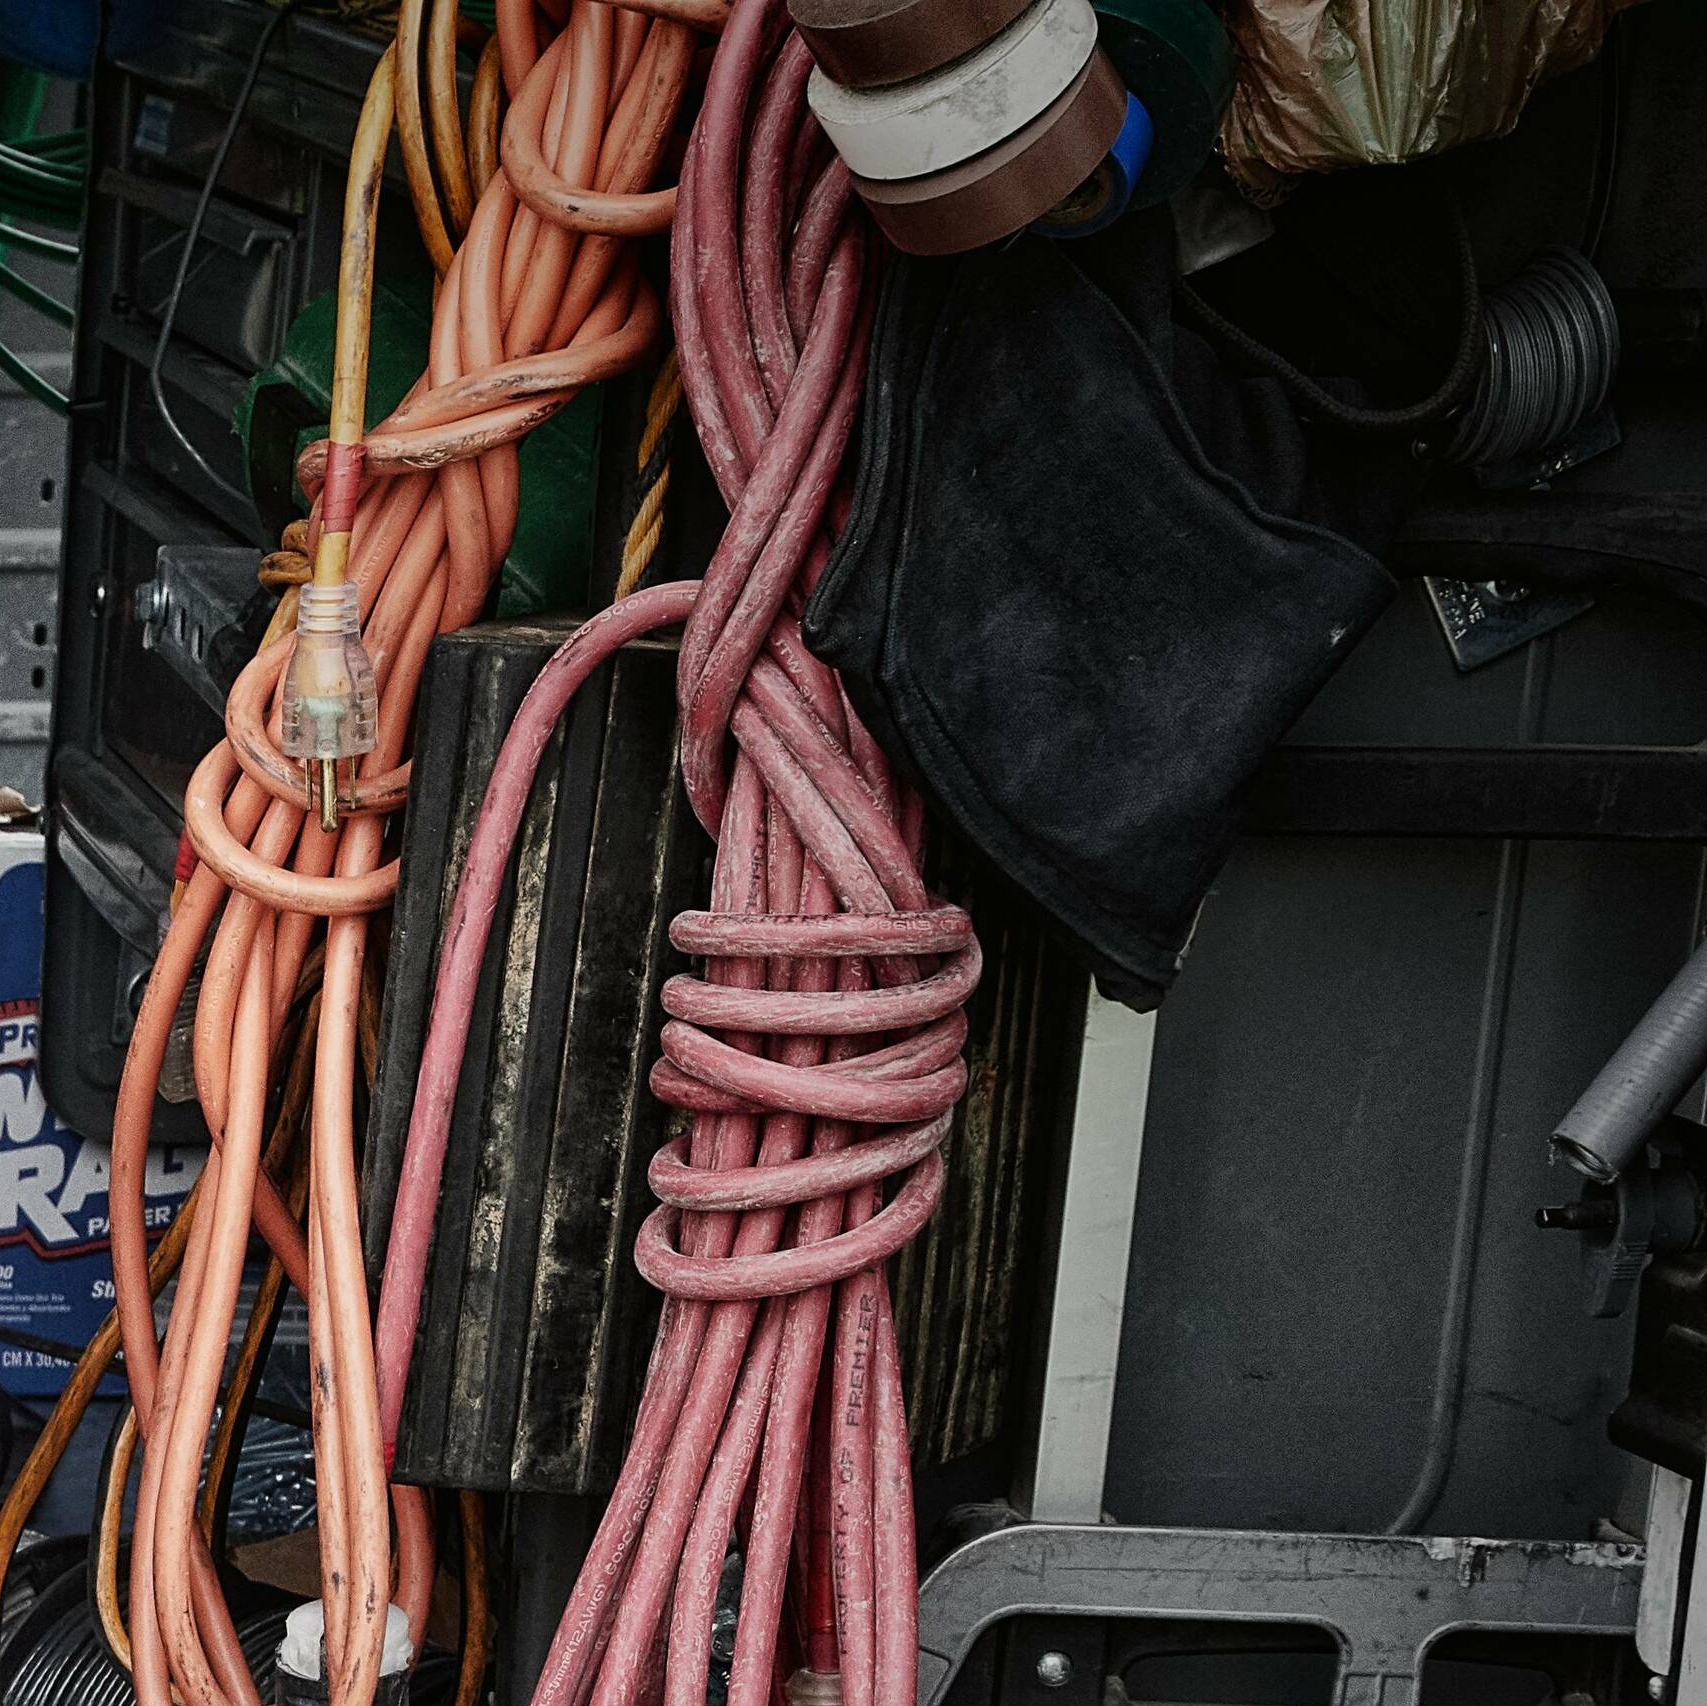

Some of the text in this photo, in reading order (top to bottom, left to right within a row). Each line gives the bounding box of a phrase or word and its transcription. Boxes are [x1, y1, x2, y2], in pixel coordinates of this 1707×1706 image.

[3, 1351, 22, 1367] CM
[844, 1292, 876, 1428] PREMIER
[836, 1447, 858, 1485] OF
